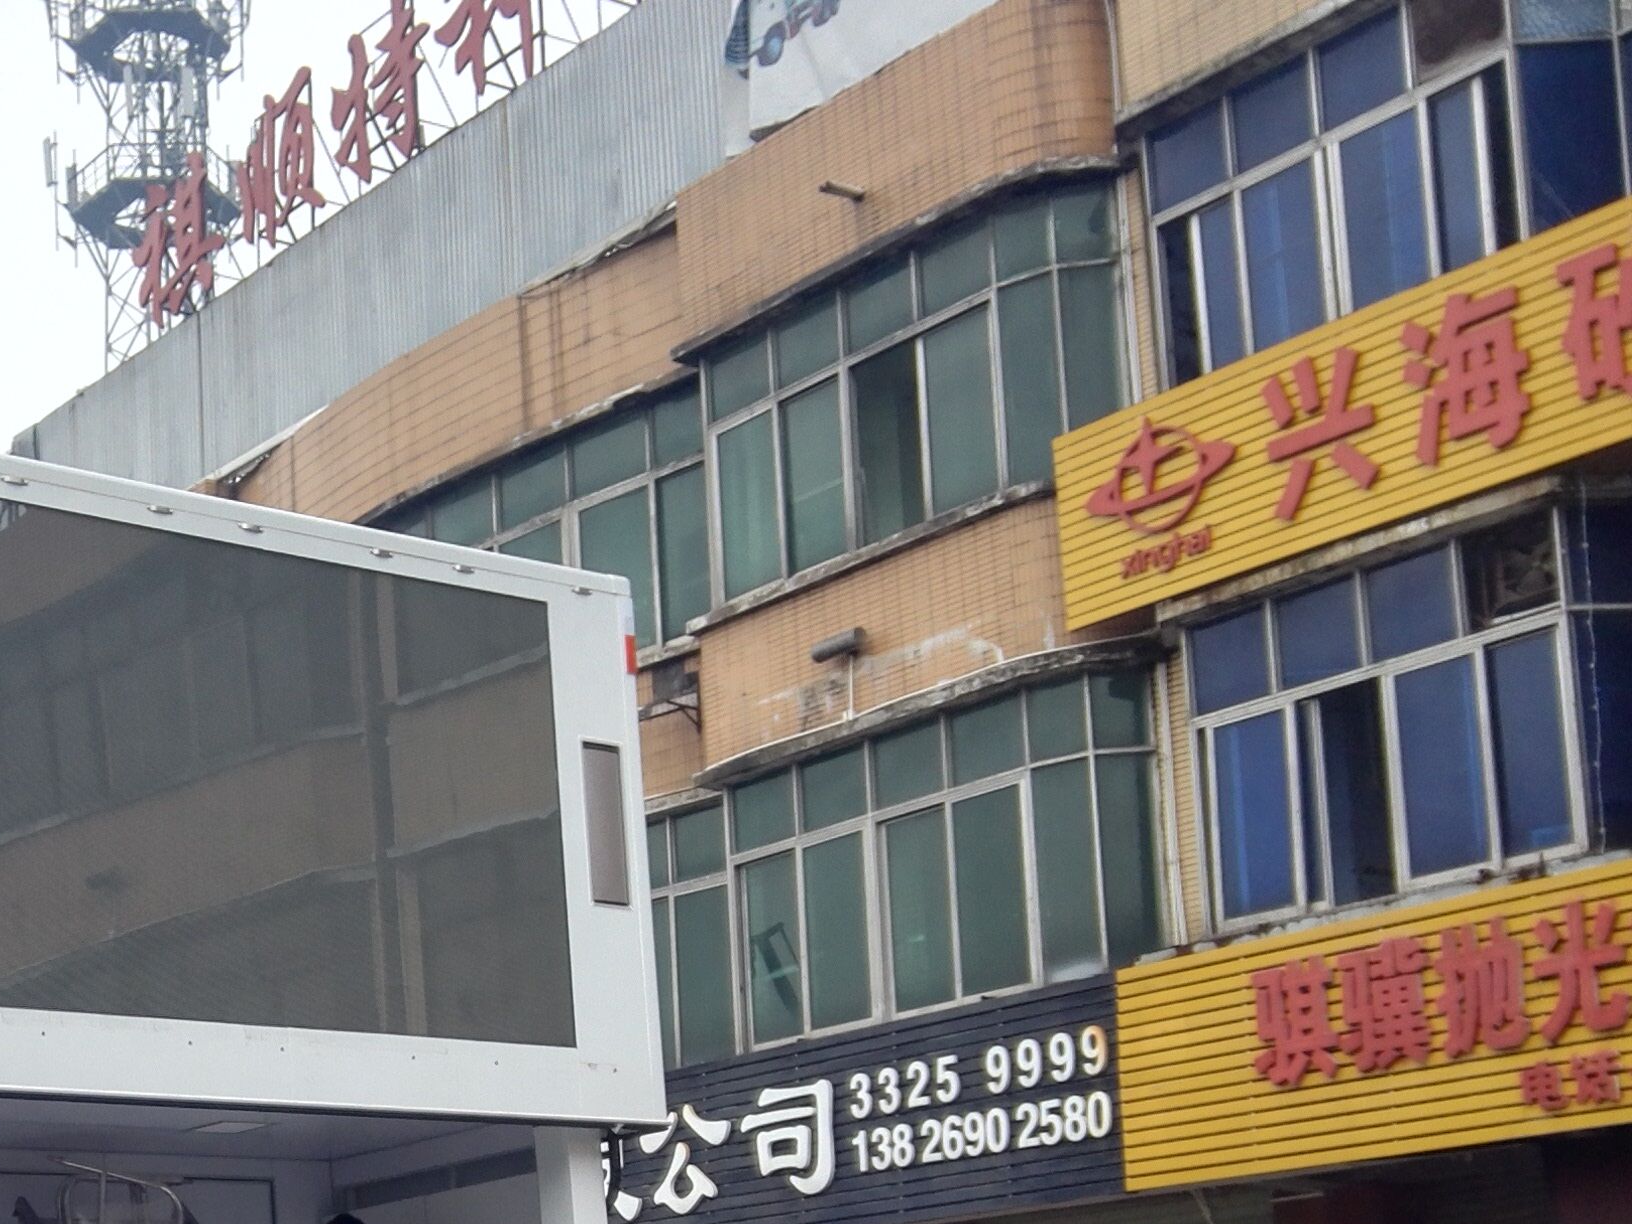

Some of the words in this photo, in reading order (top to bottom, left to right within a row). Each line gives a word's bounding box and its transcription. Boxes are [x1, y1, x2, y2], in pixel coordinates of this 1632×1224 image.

[1121, 525, 1213, 580] xinghai
[849, 1055, 961, 1119] 3325
[985, 1024, 1108, 1094] 9999
[1520, 1050, 1622, 1112] 电话
[852, 1123, 915, 1173] 138
[920, 1107, 1010, 1163] 2690
[1016, 1090, 1113, 1149] 2580
